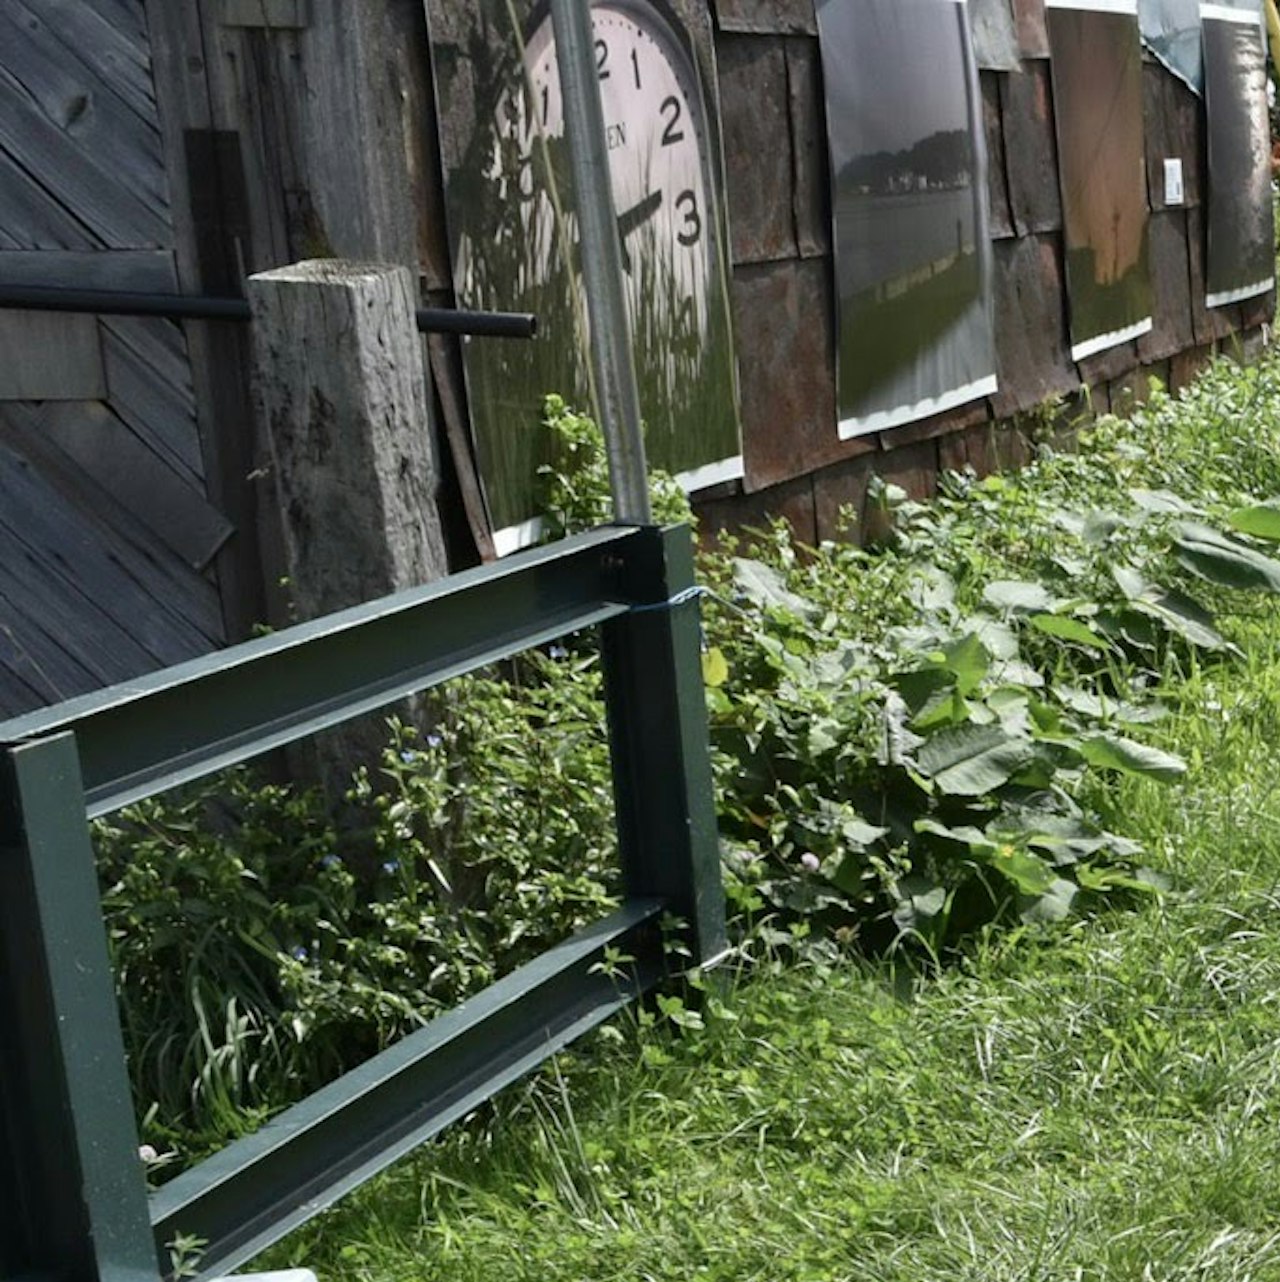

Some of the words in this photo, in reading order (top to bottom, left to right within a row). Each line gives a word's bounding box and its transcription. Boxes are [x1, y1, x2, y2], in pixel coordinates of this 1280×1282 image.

[631, 48, 641, 90] 1
[660, 95, 685, 147] 2
[675, 189, 701, 247] 3
